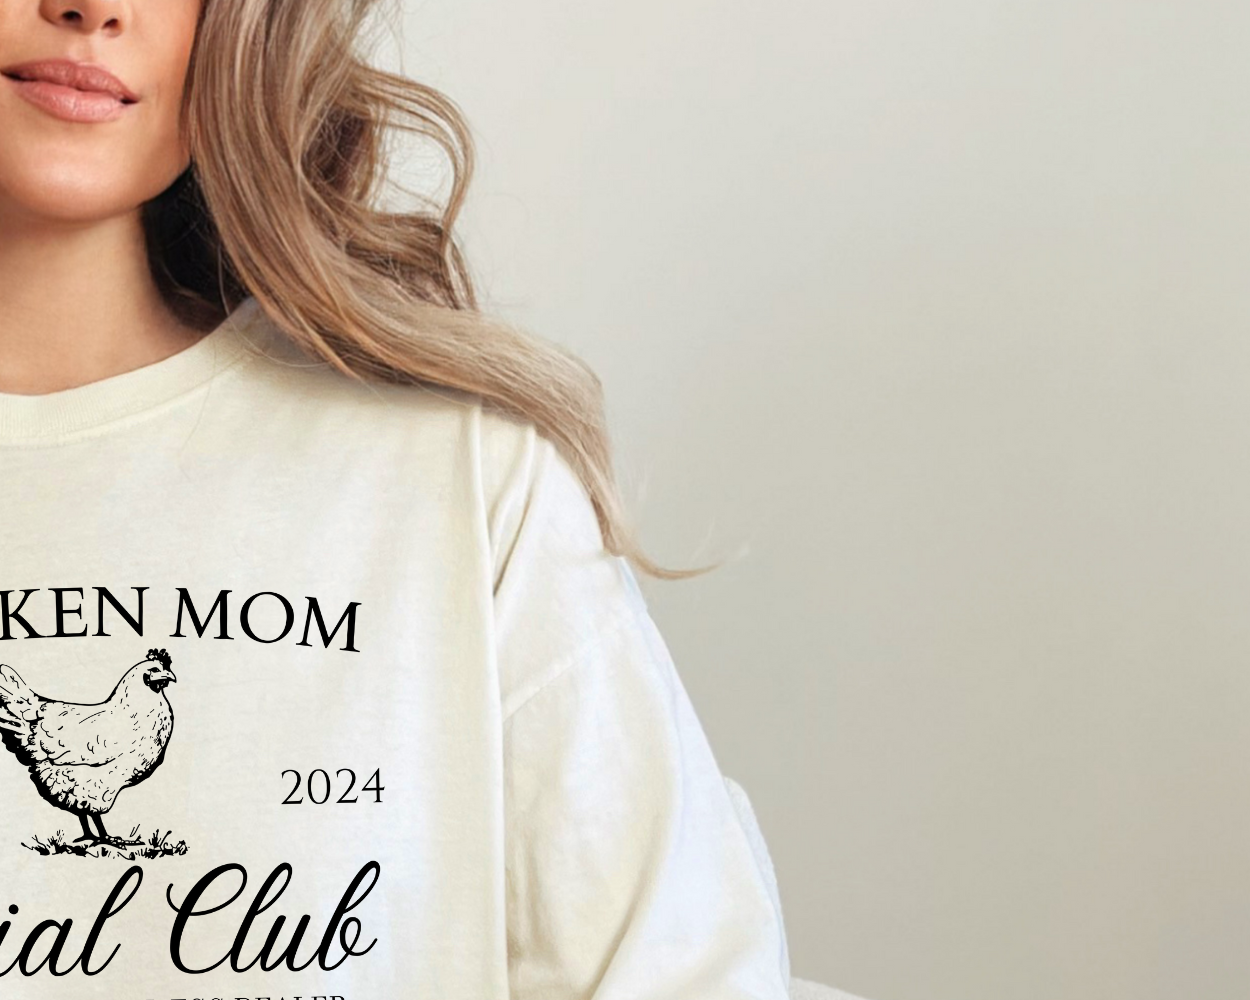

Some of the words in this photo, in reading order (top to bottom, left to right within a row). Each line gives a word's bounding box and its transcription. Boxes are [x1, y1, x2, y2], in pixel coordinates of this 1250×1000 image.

[169, 587, 362, 653] MOM
[280, 767, 385, 805] 2024
[165, 860, 381, 975] Club
